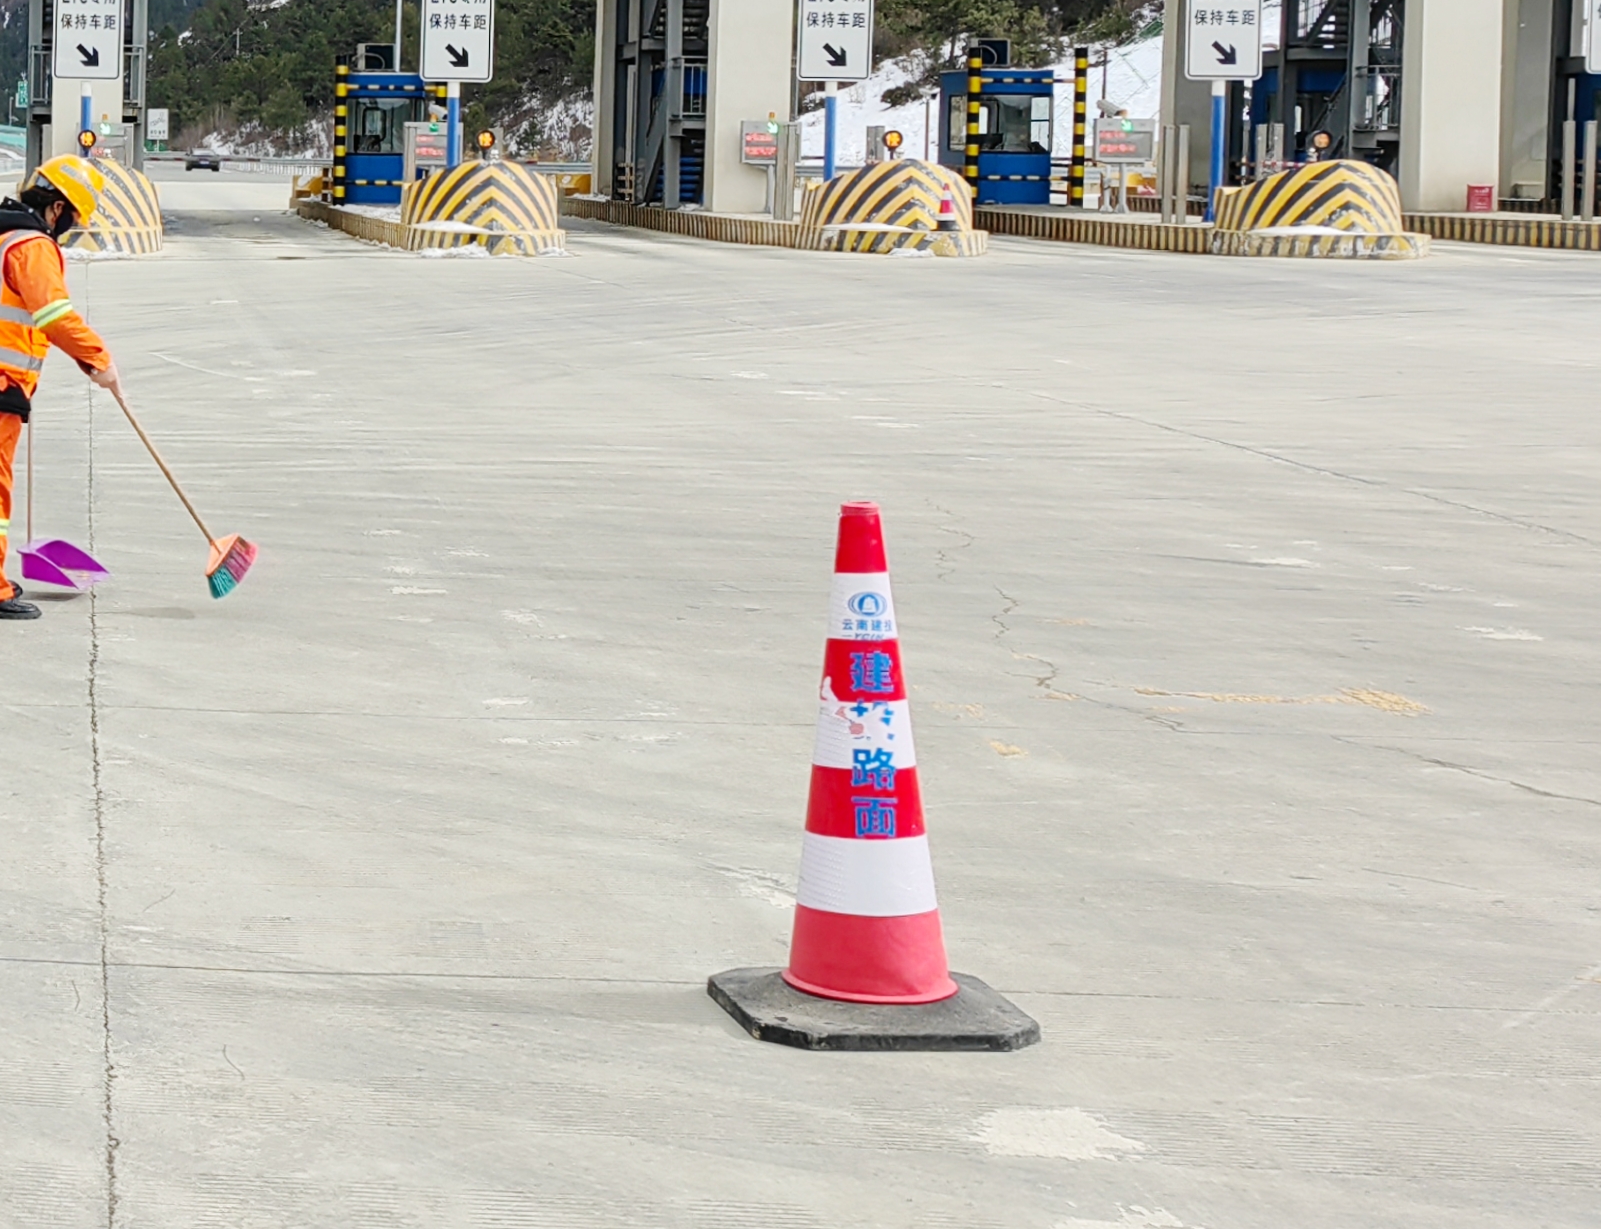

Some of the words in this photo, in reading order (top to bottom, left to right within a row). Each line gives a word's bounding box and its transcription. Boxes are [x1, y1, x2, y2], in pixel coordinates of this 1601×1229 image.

[60, 13, 116, 30] 保持车距
[429, 13, 487, 30] 保持车距
[806, 11, 866, 29] 保持车距
[1194, 9, 1255, 26] 保持车距
